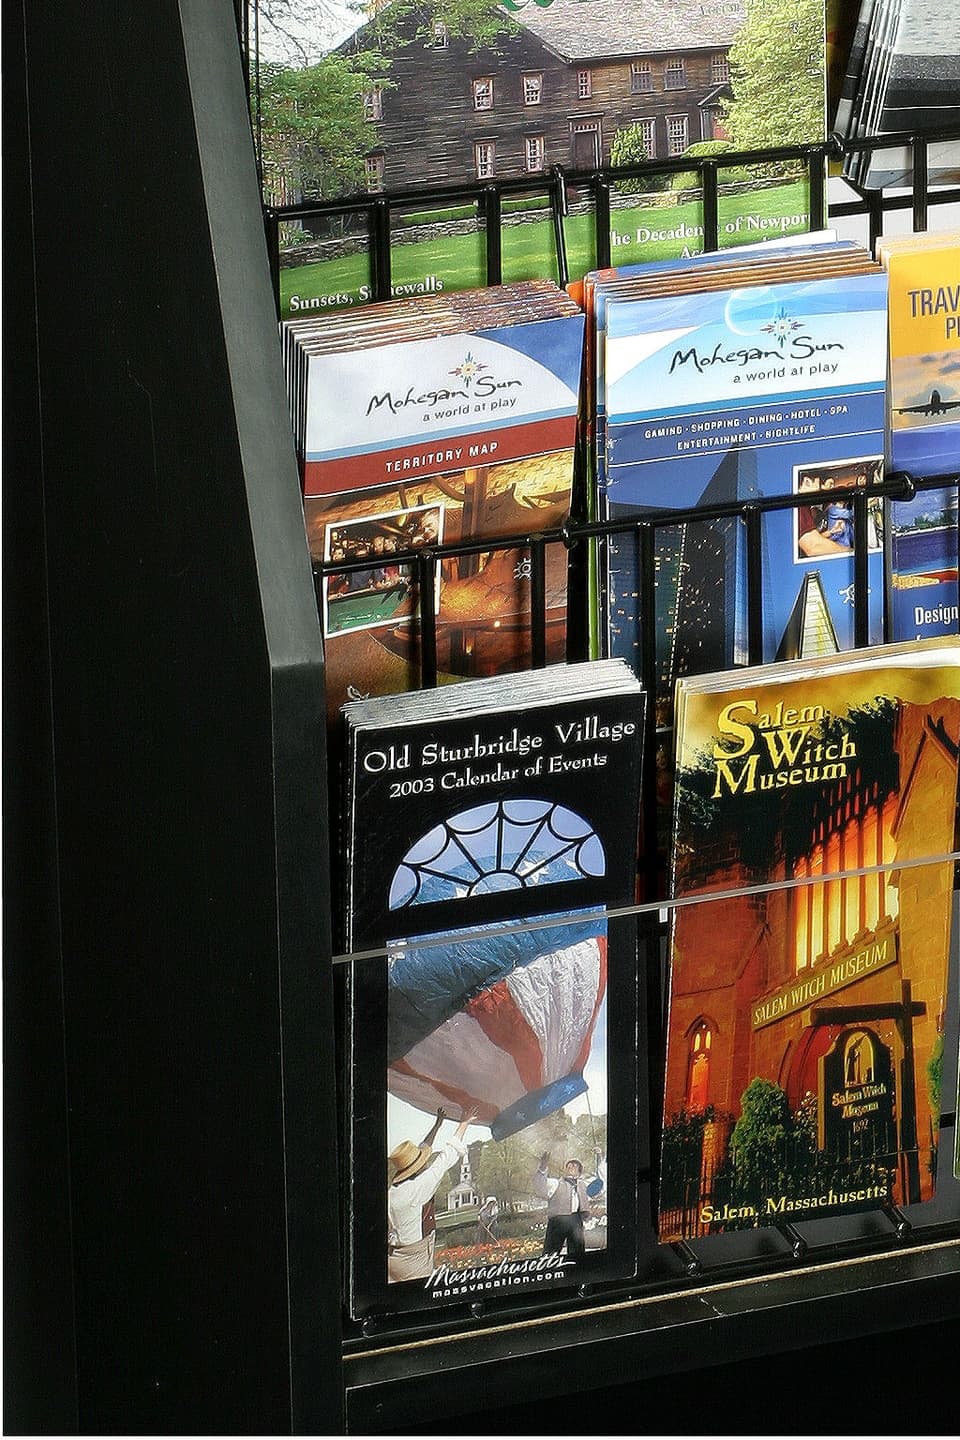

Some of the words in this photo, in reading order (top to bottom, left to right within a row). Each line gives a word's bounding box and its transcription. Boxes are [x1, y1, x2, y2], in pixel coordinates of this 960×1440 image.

[725, 216, 744, 234] of
[289, 292, 354, 312] Sunsets,
[668, 342, 785, 375] Mohegan
[790, 335, 846, 360] Sun
[365, 386, 468, 417] Mohegan
[473, 375, 523, 398] Sun
[422, 414, 430, 422] a
[434, 404, 470, 419] world
[474, 403, 487, 413] at
[490, 396, 518, 414] play
[677, 431, 757, 451] ENTERTAINMENT
[691, 418, 740, 435] SHOPPING
[748, 412, 784, 425] DINING
[385, 448, 463, 473] TERRITORY
[469, 442, 499, 458] MAP
[363, 745, 410, 773] Old
[422, 728, 543, 766] Sturbridge
[555, 715, 636, 744] Village
[713, 699, 825, 760] Salem
[761, 726, 857, 769] Witch
[389, 776, 435, 799] 2003
[441, 763, 519, 791] Calendar
[524, 757, 543, 777] of
[549, 752, 608, 774] Events
[711, 754, 848, 799] Museum
[753, 993, 789, 1025] SALEM
[791, 973, 826, 1005] WITCH
[829, 940, 888, 988] MUSEUM
[766, 1184, 888, 1215] Massachusetts
[425, 1252, 576, 1289] Massachusetts
[432, 1269, 565, 1299] massvacation.com
